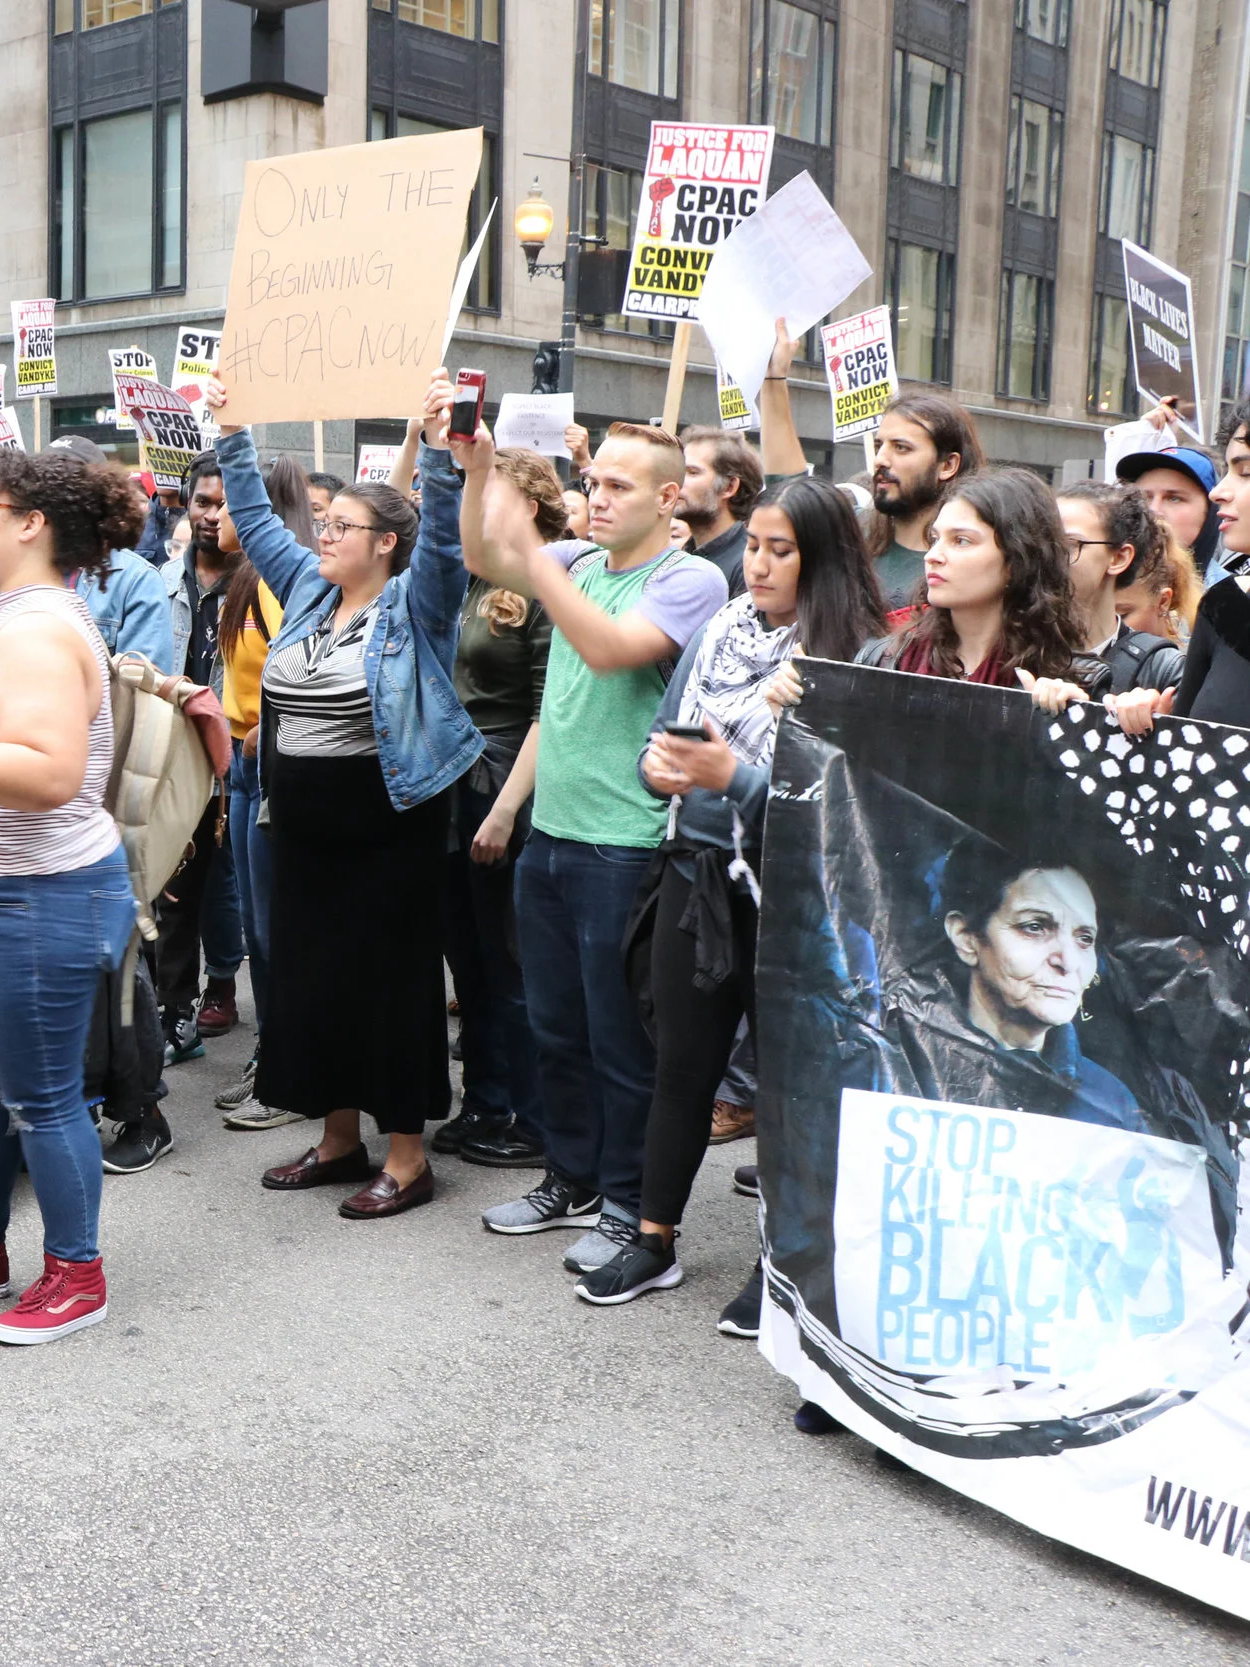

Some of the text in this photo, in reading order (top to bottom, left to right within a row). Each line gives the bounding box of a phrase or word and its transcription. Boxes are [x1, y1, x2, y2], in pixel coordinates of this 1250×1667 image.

[654, 127, 767, 152] JUSTICE FOR
[651, 147, 763, 181] LAQUAN
[254, 168, 455, 238] ONLY THE
[677, 183, 759, 217] CPAC
[245, 249, 393, 311] BEGINNING
[1129, 276, 1189, 340] BLACK LIVES
[28, 328, 53, 343] CPAC
[28, 342, 53, 358] NOW
[1143, 322, 1182, 373] MATTER
[19, 359, 53, 372] CONVICT
[844, 342, 888, 372] CPAC
[18, 370, 55, 384] VANDYKE
[847, 360, 889, 390] NOW
[122, 387, 192, 412] LAQUAN
[836, 382, 890, 410] CONVICT
[147, 411, 199, 432] CPAC
[154, 428, 202, 451] NOW
[884, 1104, 1018, 1176] STOP
[882, 1163, 1079, 1238] KILLING
[878, 1220, 1114, 1323] BLACK
[877, 1305, 1052, 1374] PEOPLE
